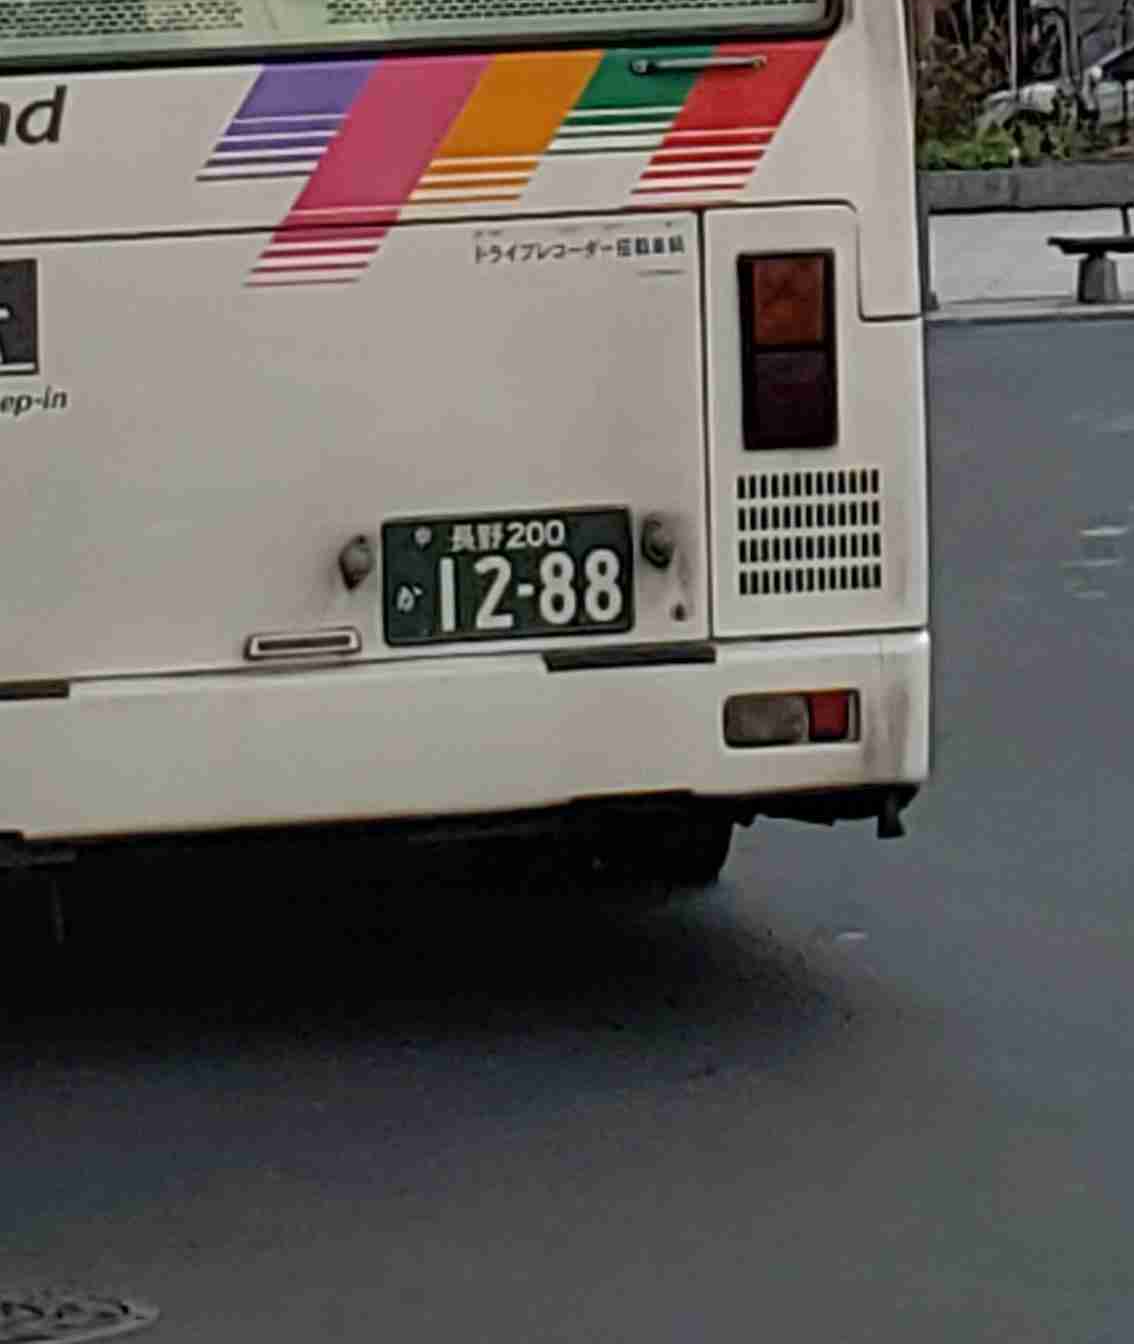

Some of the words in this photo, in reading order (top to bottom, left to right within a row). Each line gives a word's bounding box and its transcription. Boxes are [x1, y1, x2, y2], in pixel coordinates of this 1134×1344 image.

[0, 84, 67, 145] d
[450, 519, 566, 552] 長野200
[396, 584, 423, 613] か
[439, 548, 623, 632] 12-88
